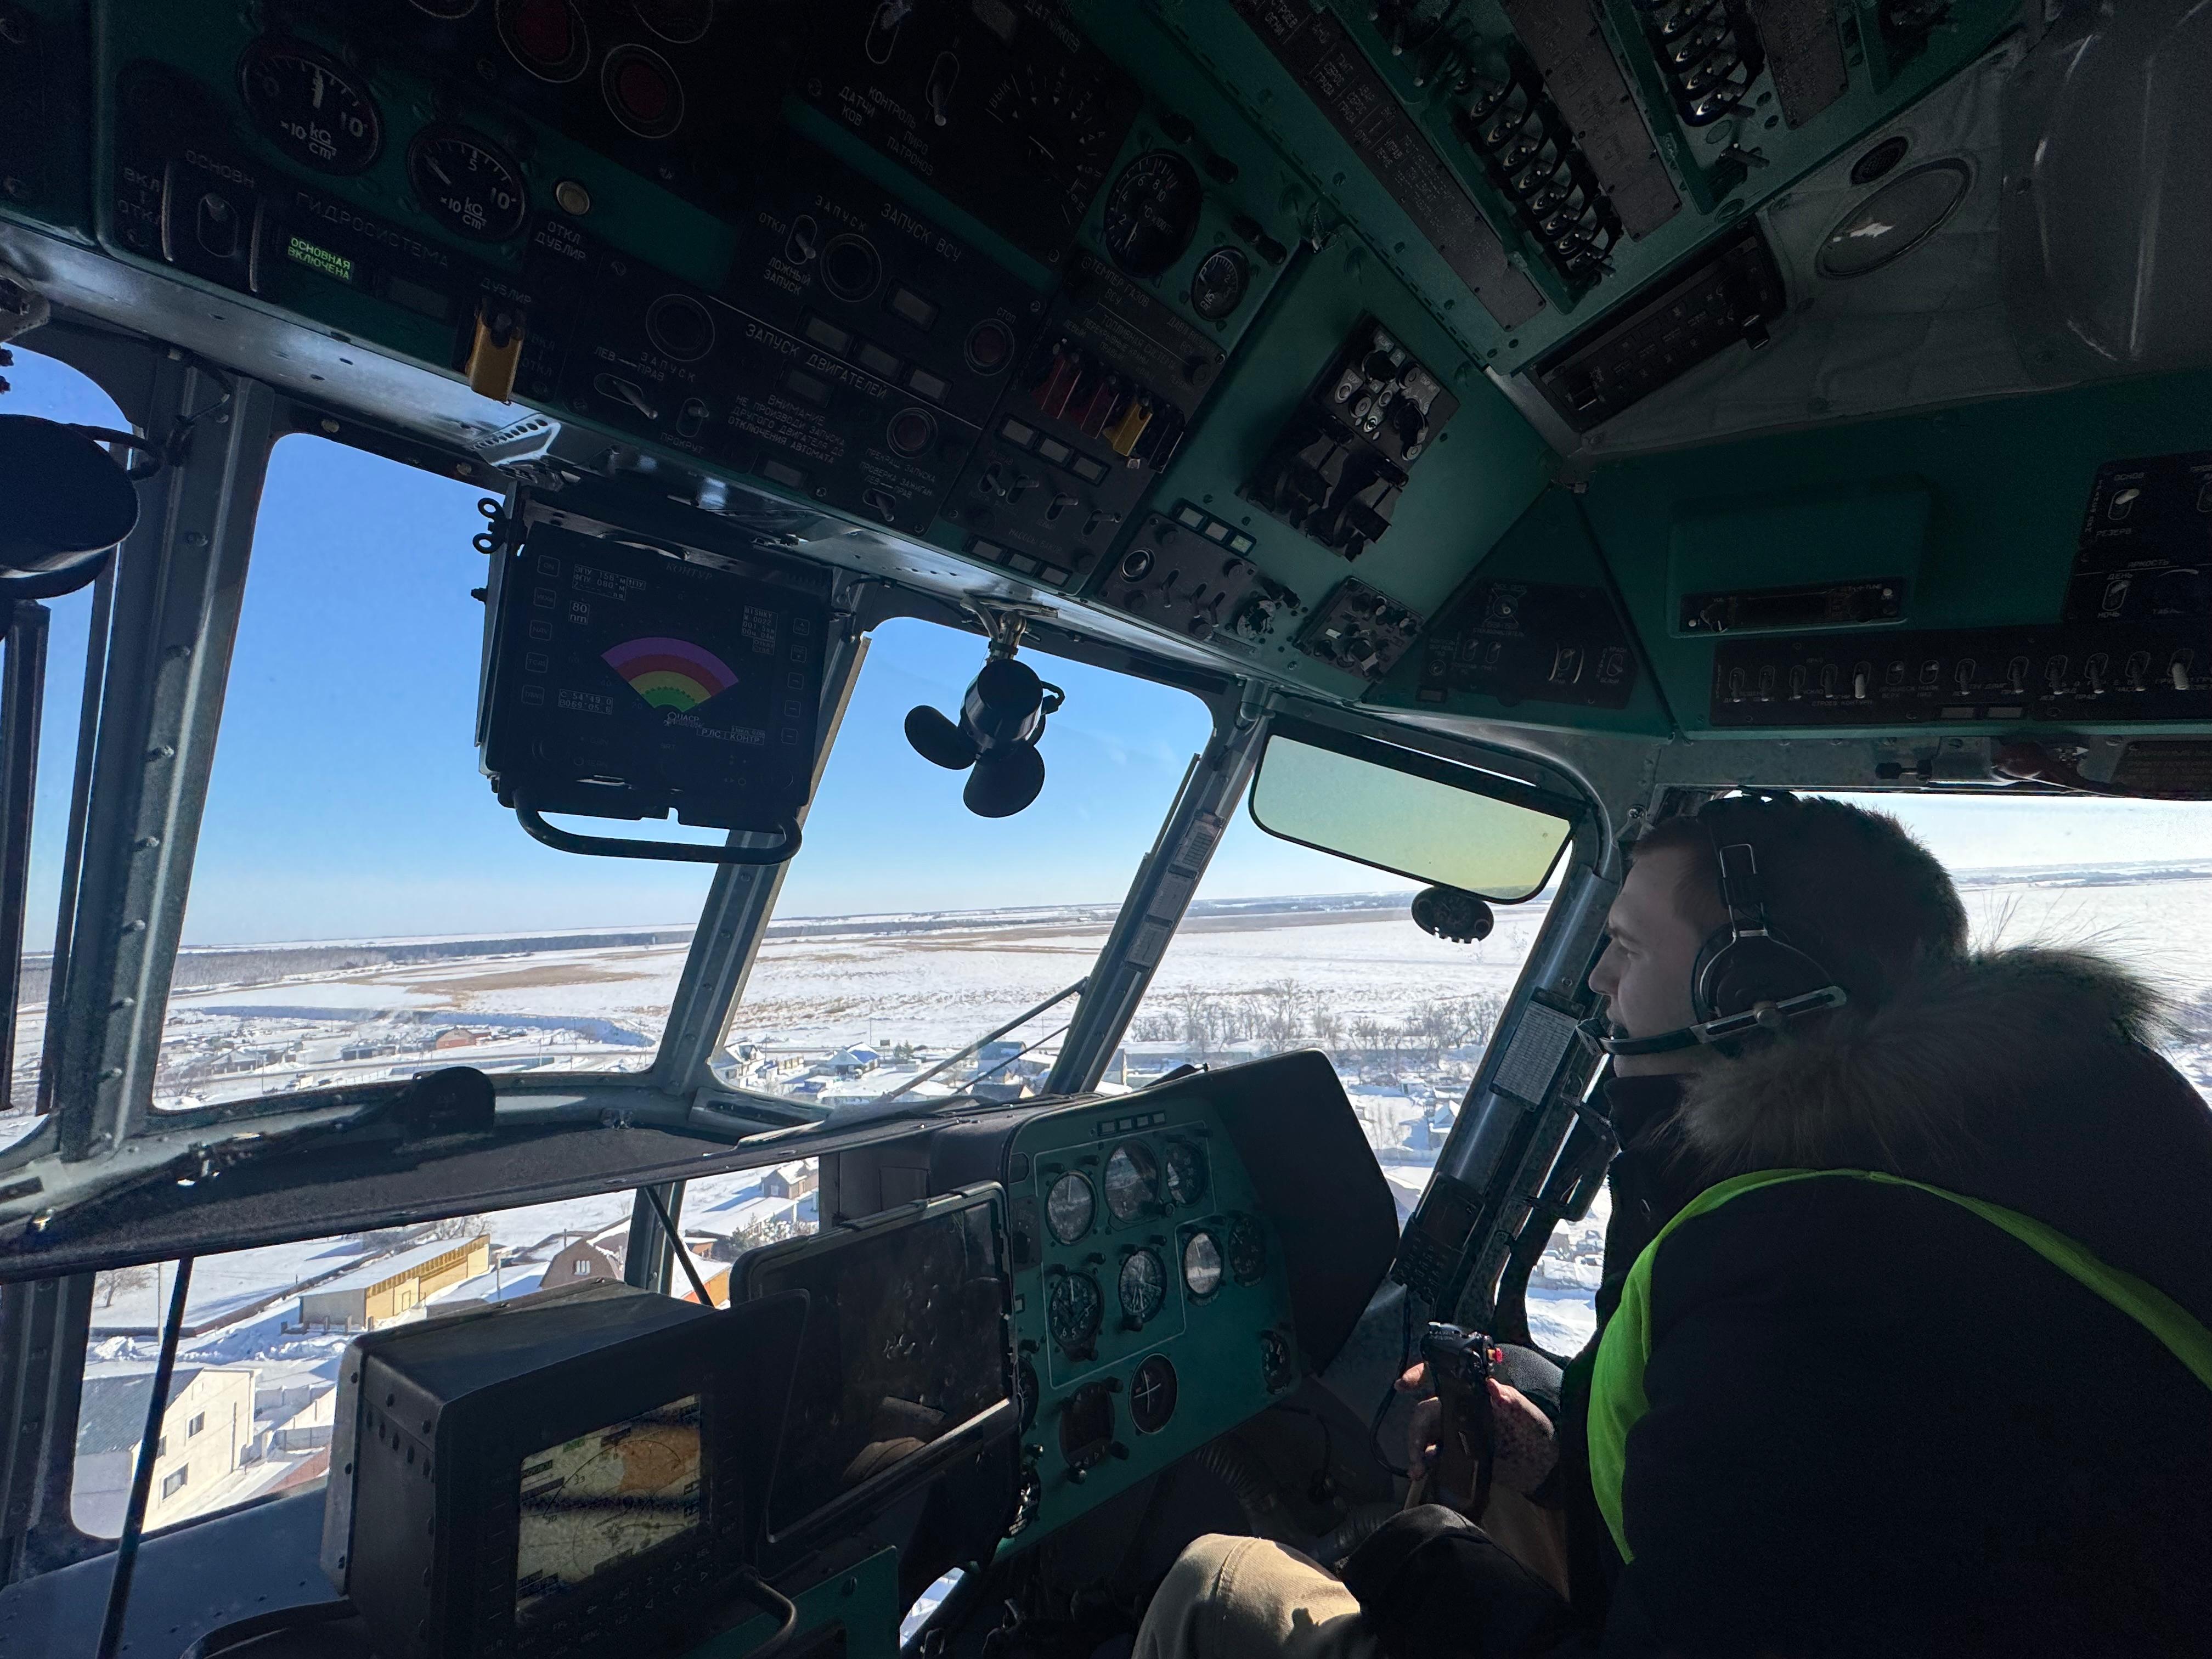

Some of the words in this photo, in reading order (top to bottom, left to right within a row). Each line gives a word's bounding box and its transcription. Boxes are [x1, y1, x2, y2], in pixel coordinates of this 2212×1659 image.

[840, 104, 864, 127] КОВ
[867, 86, 916, 129] КОНТРОЛЬ
[185, 149, 255, 188] ОСНОВН
[758, 212, 787, 235] ОТКЛ
[815, 194, 867, 233] ЗАПУСК
[296, 191, 448, 267] ГИДРОСИСТЕМА
[548, 222, 582, 245] ОТКЛ
[880, 202, 932, 245] ЗАПУСК
[934, 237, 962, 263] ВСУ
[290, 236, 352, 269] ОСНОВНАЯ
[535, 232, 586, 261] ДУБЛИР
[287, 246, 350, 280] ВКЛЮЧЕНА
[768, 256, 811, 287] ЛОЖНЫЙ
[481, 277, 532, 304] ДУБЛИР
[763, 269, 803, 297] ЗАПУСК
[1089, 259, 1126, 289] ТЕМПЕР
[1122, 284, 1151, 308] ГАЗОВ
[1103, 288, 1123, 306] ВСУ
[996, 306, 1017, 325] СТОП
[1100, 314, 1144, 349] ТОПЛИВНАЯ
[594, 347, 616, 362] ЛЕВ
[640, 351, 696, 382] ЗАПУСК
[744, 323, 799, 358] ЗАПУСК
[805, 353, 888, 400] ДВИГАТЕЛЕЙ
[636, 363, 664, 382] ПРАВ
[735, 394, 749, 407] НЕ
[752, 401, 806, 431] ПРОИЗВОДИ
[808, 425, 845, 447] ЗАПУСКА
[767, 394, 826, 426] ВНИМАНИЕ
[661, 432, 705, 454] ПРОКРУТ
[726, 414, 788, 447] ОТКЛЮЧЕНИЯ
[789, 439, 835, 465] АВТОМАТА
[731, 404, 775, 430] ДРУГОГО
[778, 424, 828, 452] ДВИГАТЕЛЯ
[830, 445, 845, 458] ДО
[859, 460, 898, 483] ПРОВЕРКА
[904, 464, 936, 483] ЗАПУСКА
[2128, 558, 2170, 568] ЯРКОСТЬ
[570, 614, 587, 623] nm
[572, 603, 587, 613] 80
[702, 729, 721, 738] РЛС
